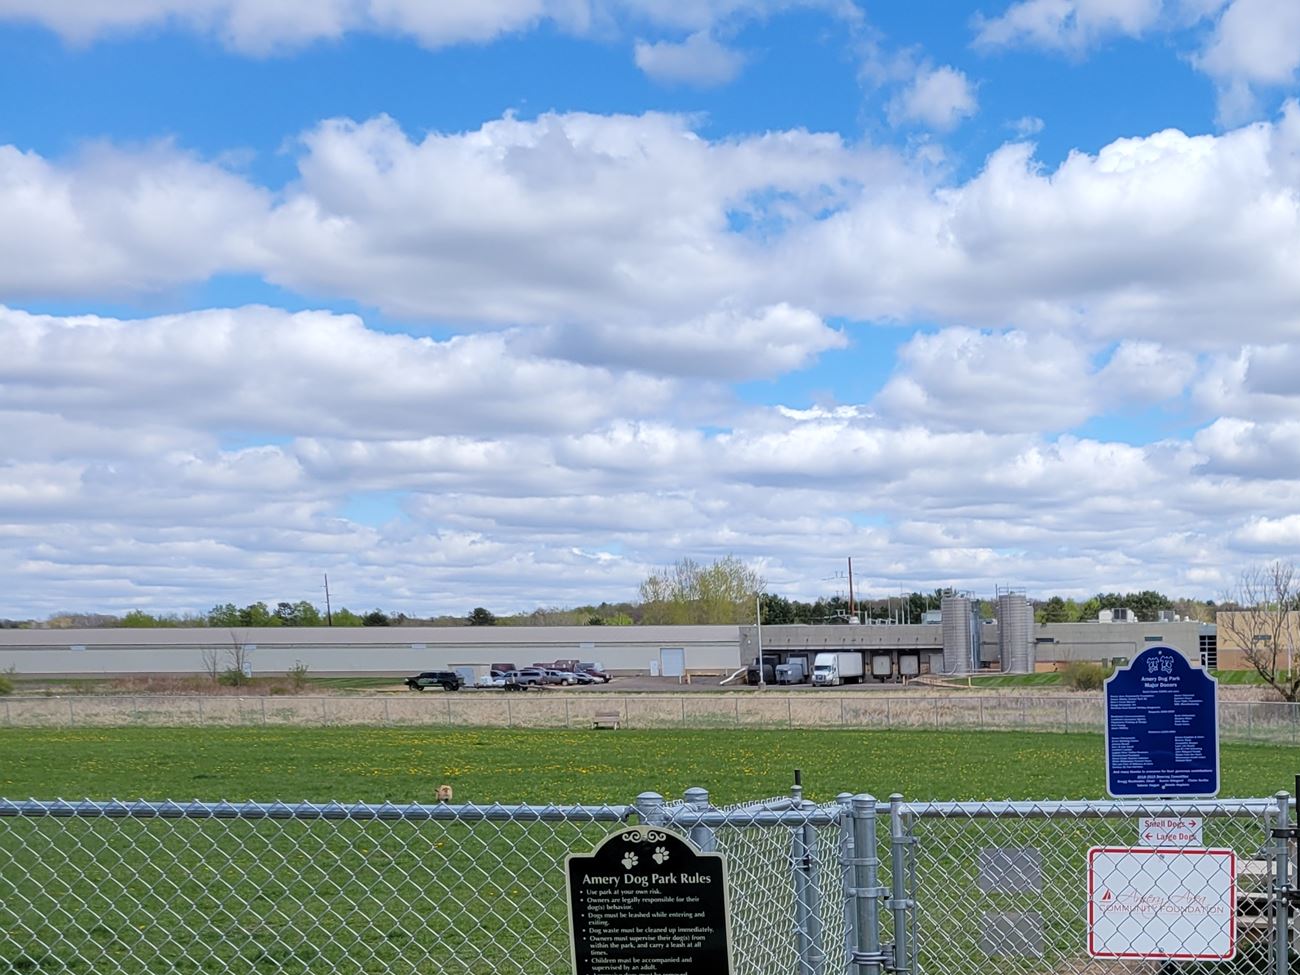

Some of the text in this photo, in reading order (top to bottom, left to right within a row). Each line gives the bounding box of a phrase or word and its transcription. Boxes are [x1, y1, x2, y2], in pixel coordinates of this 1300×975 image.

[1144, 820, 1185, 828] Small Dogs
[1156, 833, 1177, 841] Large
[583, 873, 712, 888] Amery Dog Park Rules
[622, 896, 640, 904] legally
[642, 896, 675, 904] responsible
[1100, 904, 1224, 914] COMMUNITY FOUNDATION
[669, 911, 693, 919] entering
[677, 926, 714, 934] immediately.
[592, 964, 622, 972] supervised
[624, 964, 630, 972] by
